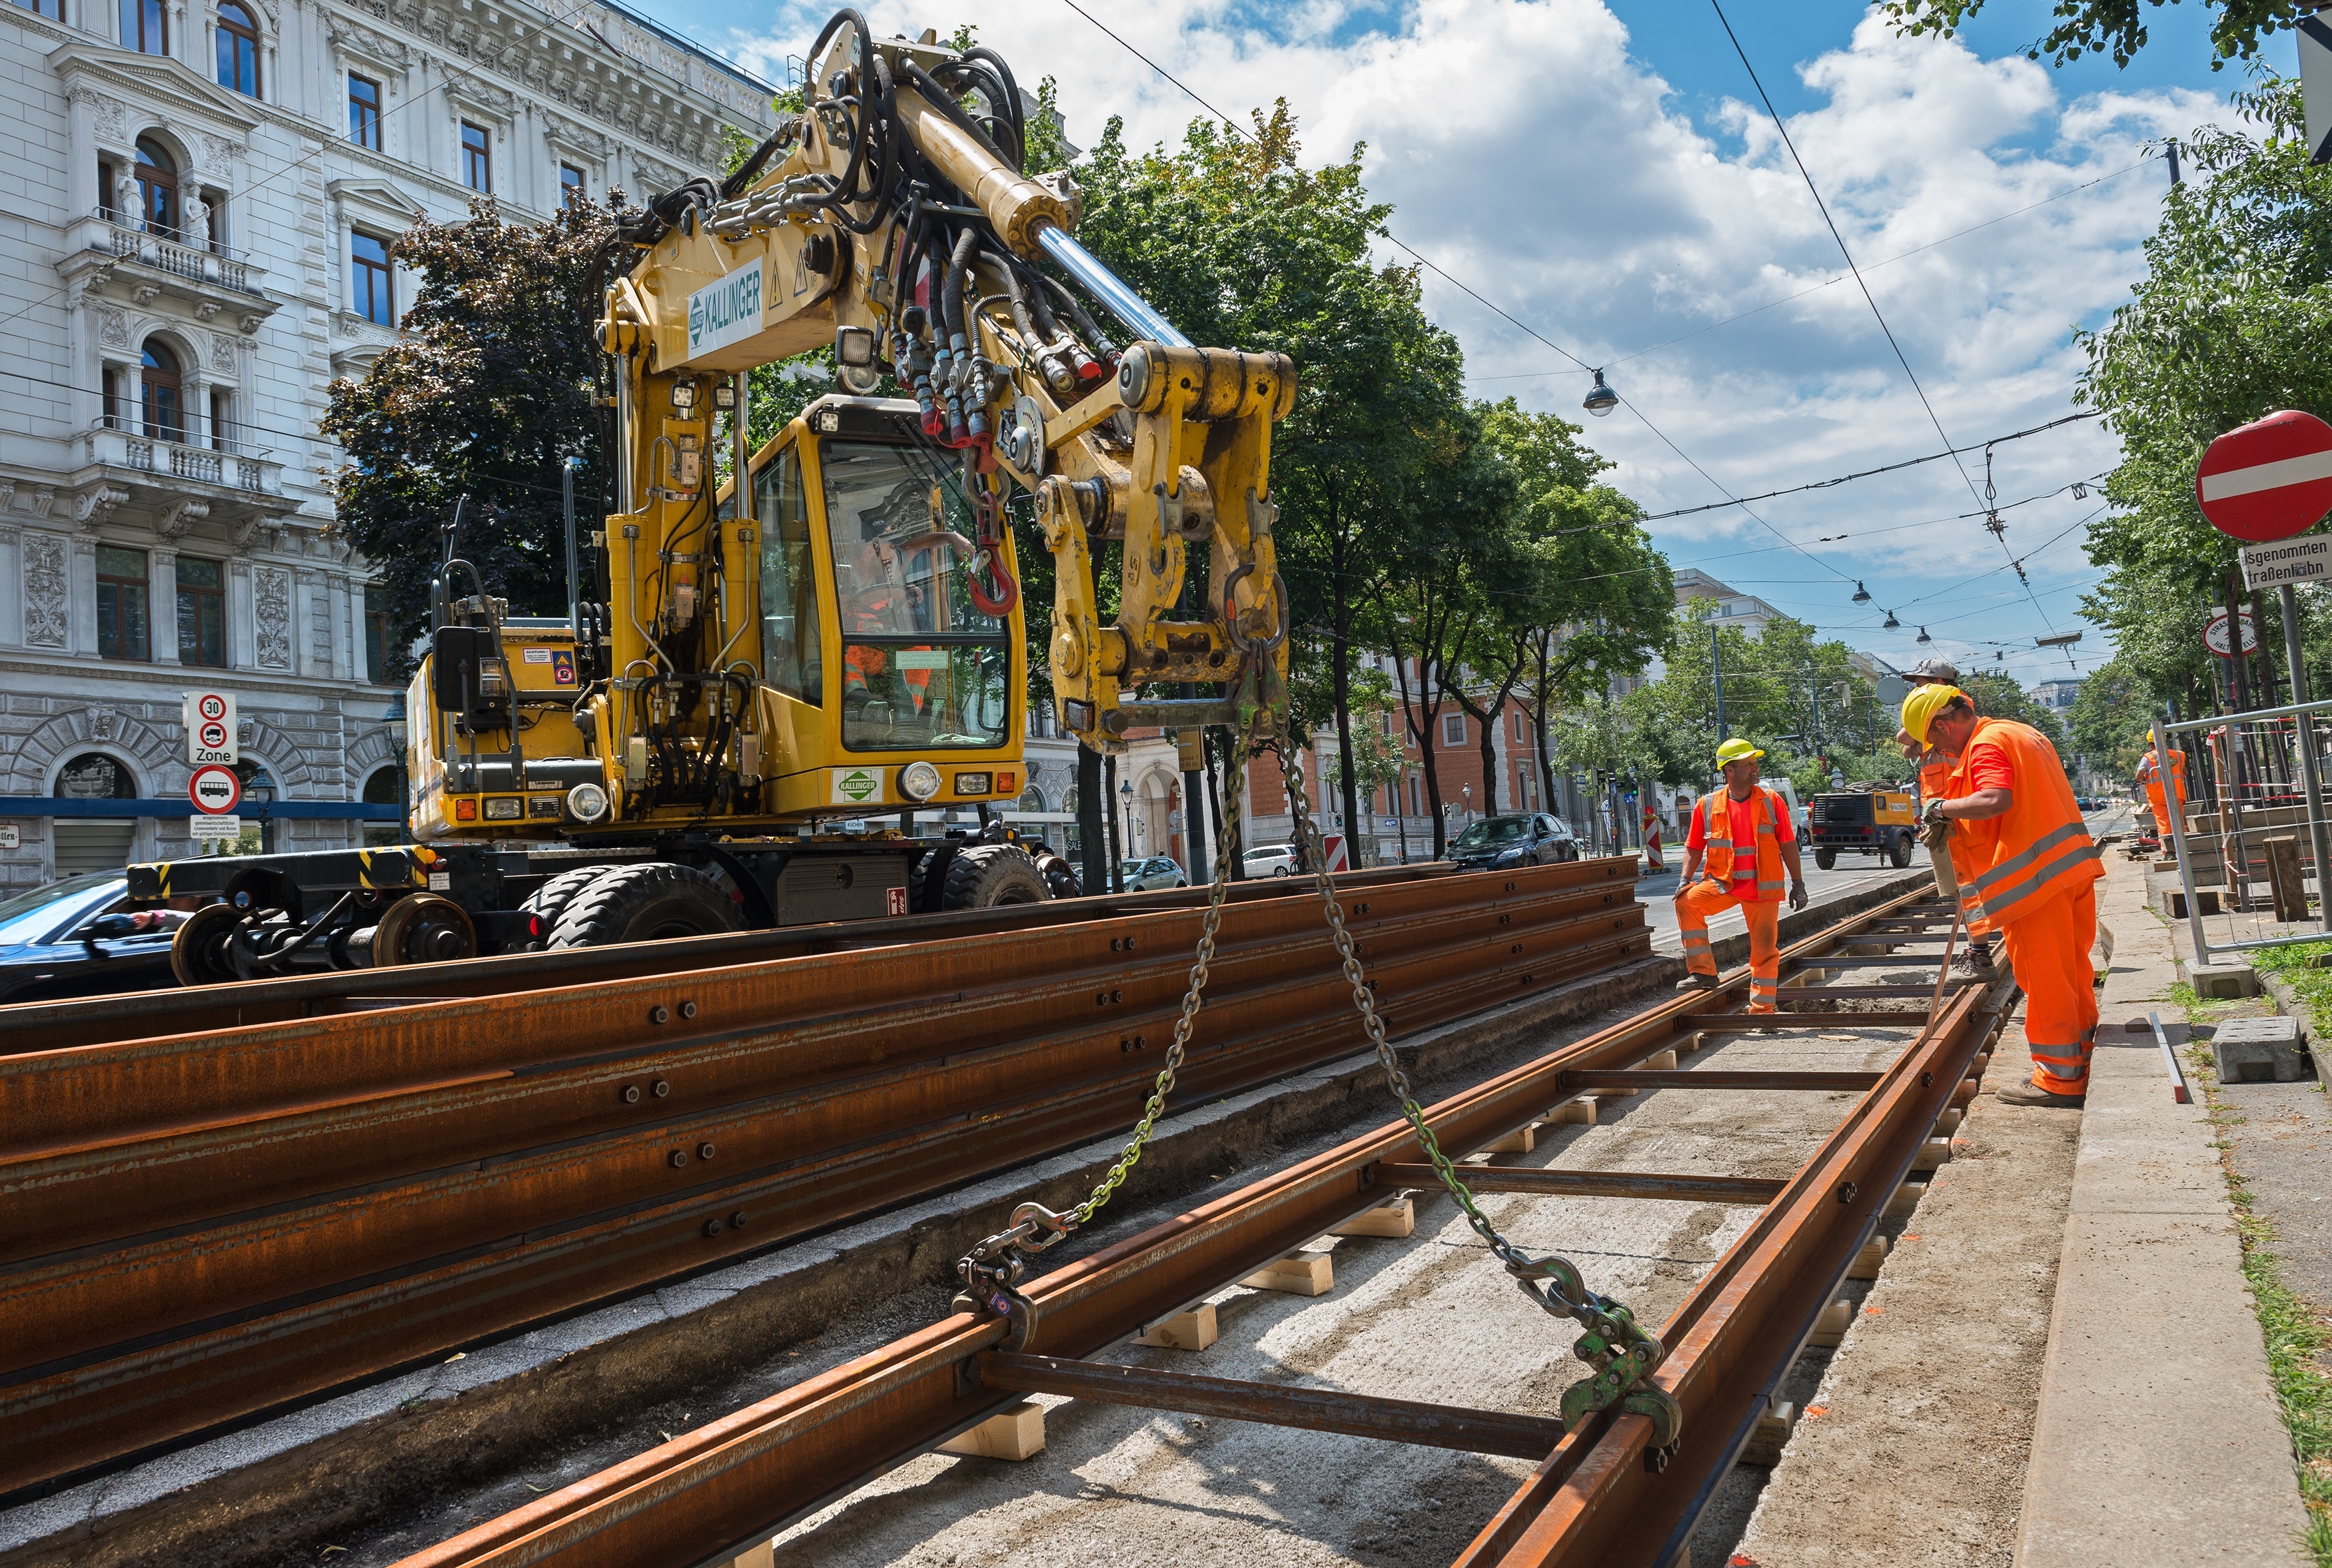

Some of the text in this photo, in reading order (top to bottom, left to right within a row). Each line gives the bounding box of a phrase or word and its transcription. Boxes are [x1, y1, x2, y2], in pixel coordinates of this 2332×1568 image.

[705, 270, 760, 334] KALLINGER
[2247, 561, 2324, 584] traßenhn
[207, 701, 219, 713] 30
[197, 748, 231, 761] Zone
[840, 781, 875, 790] KALLINGER
[1067, 841, 1081, 851] SALE
